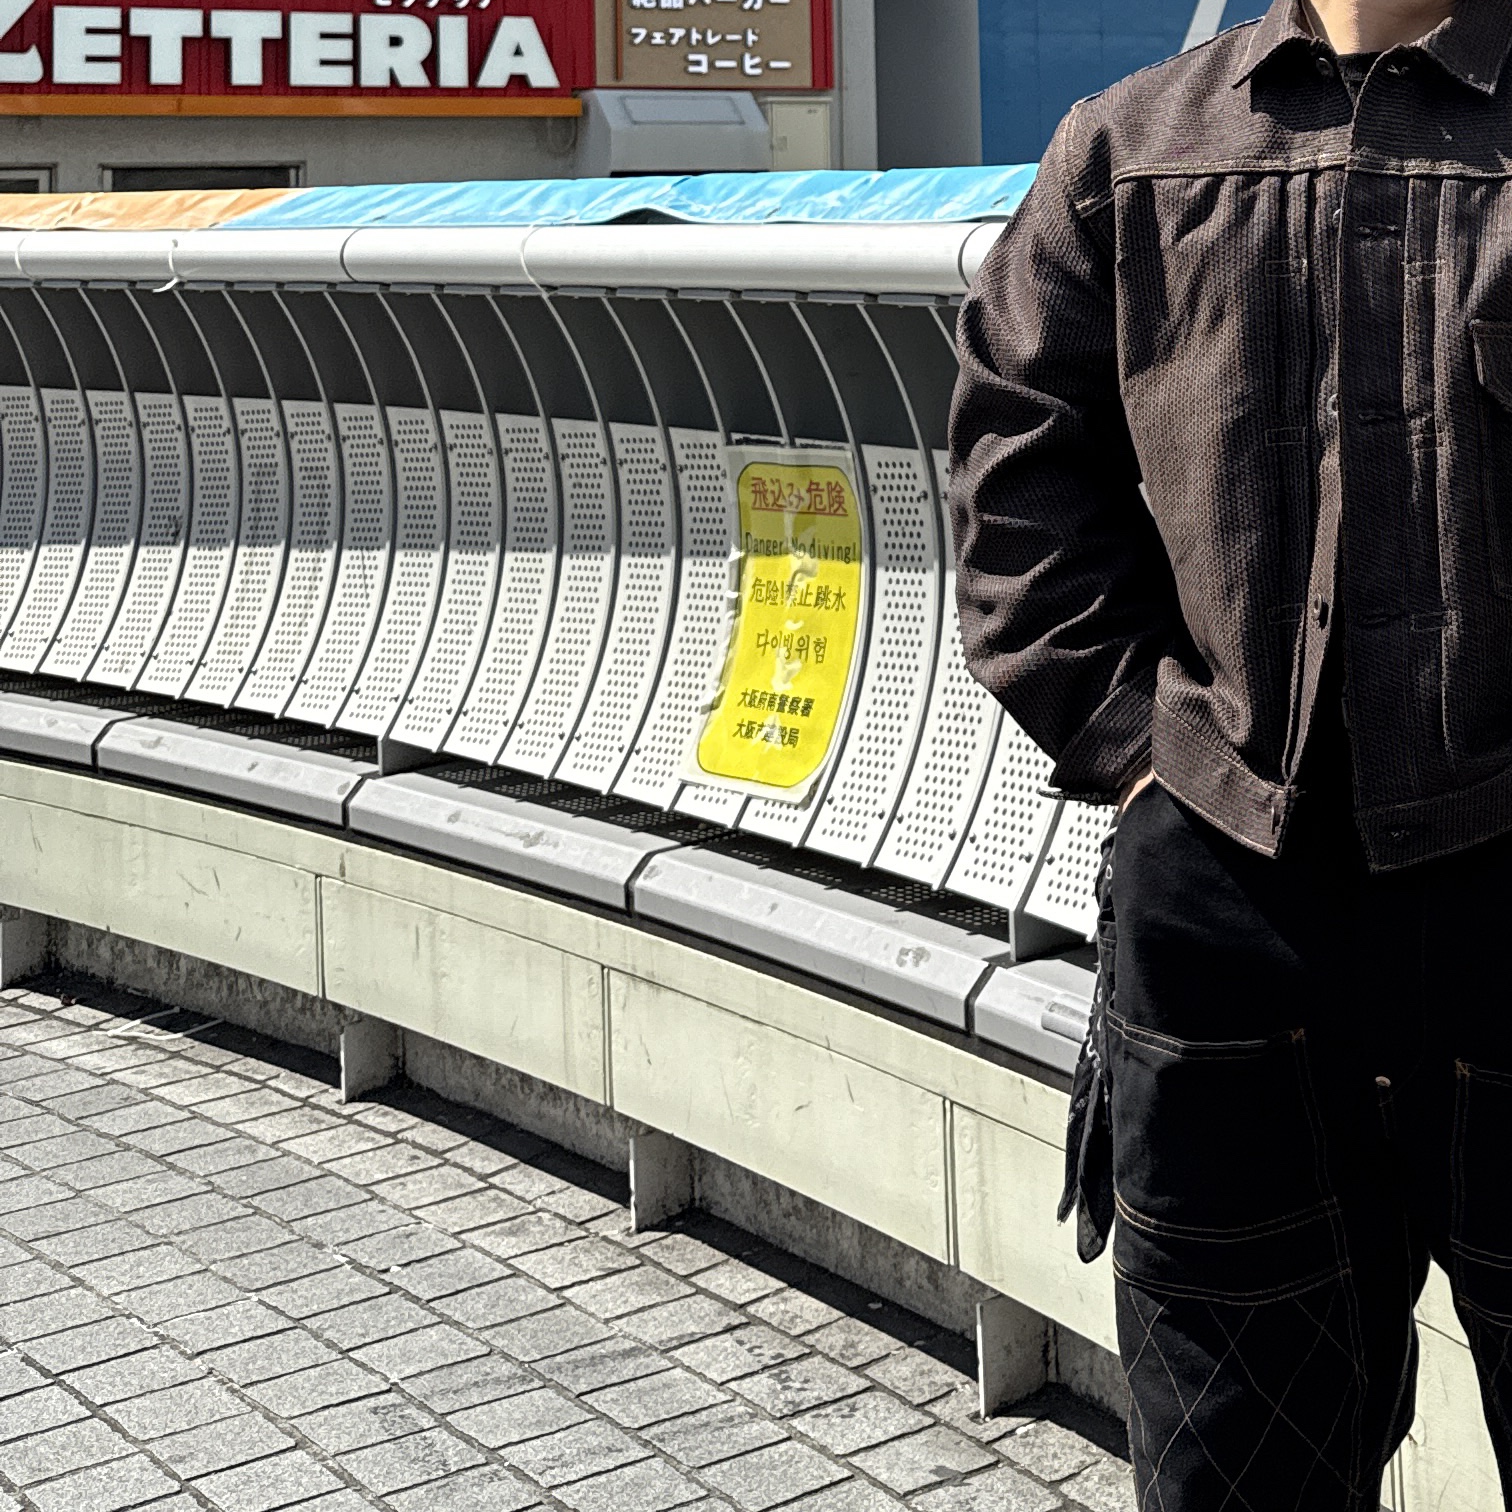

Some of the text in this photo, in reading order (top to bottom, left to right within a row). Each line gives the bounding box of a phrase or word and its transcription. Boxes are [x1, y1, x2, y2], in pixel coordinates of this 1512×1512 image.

[629, 26, 760, 48] フェアトレード
[685, 52, 793, 78] コーヒー
[750, 476, 848, 515] 飛込み危険
